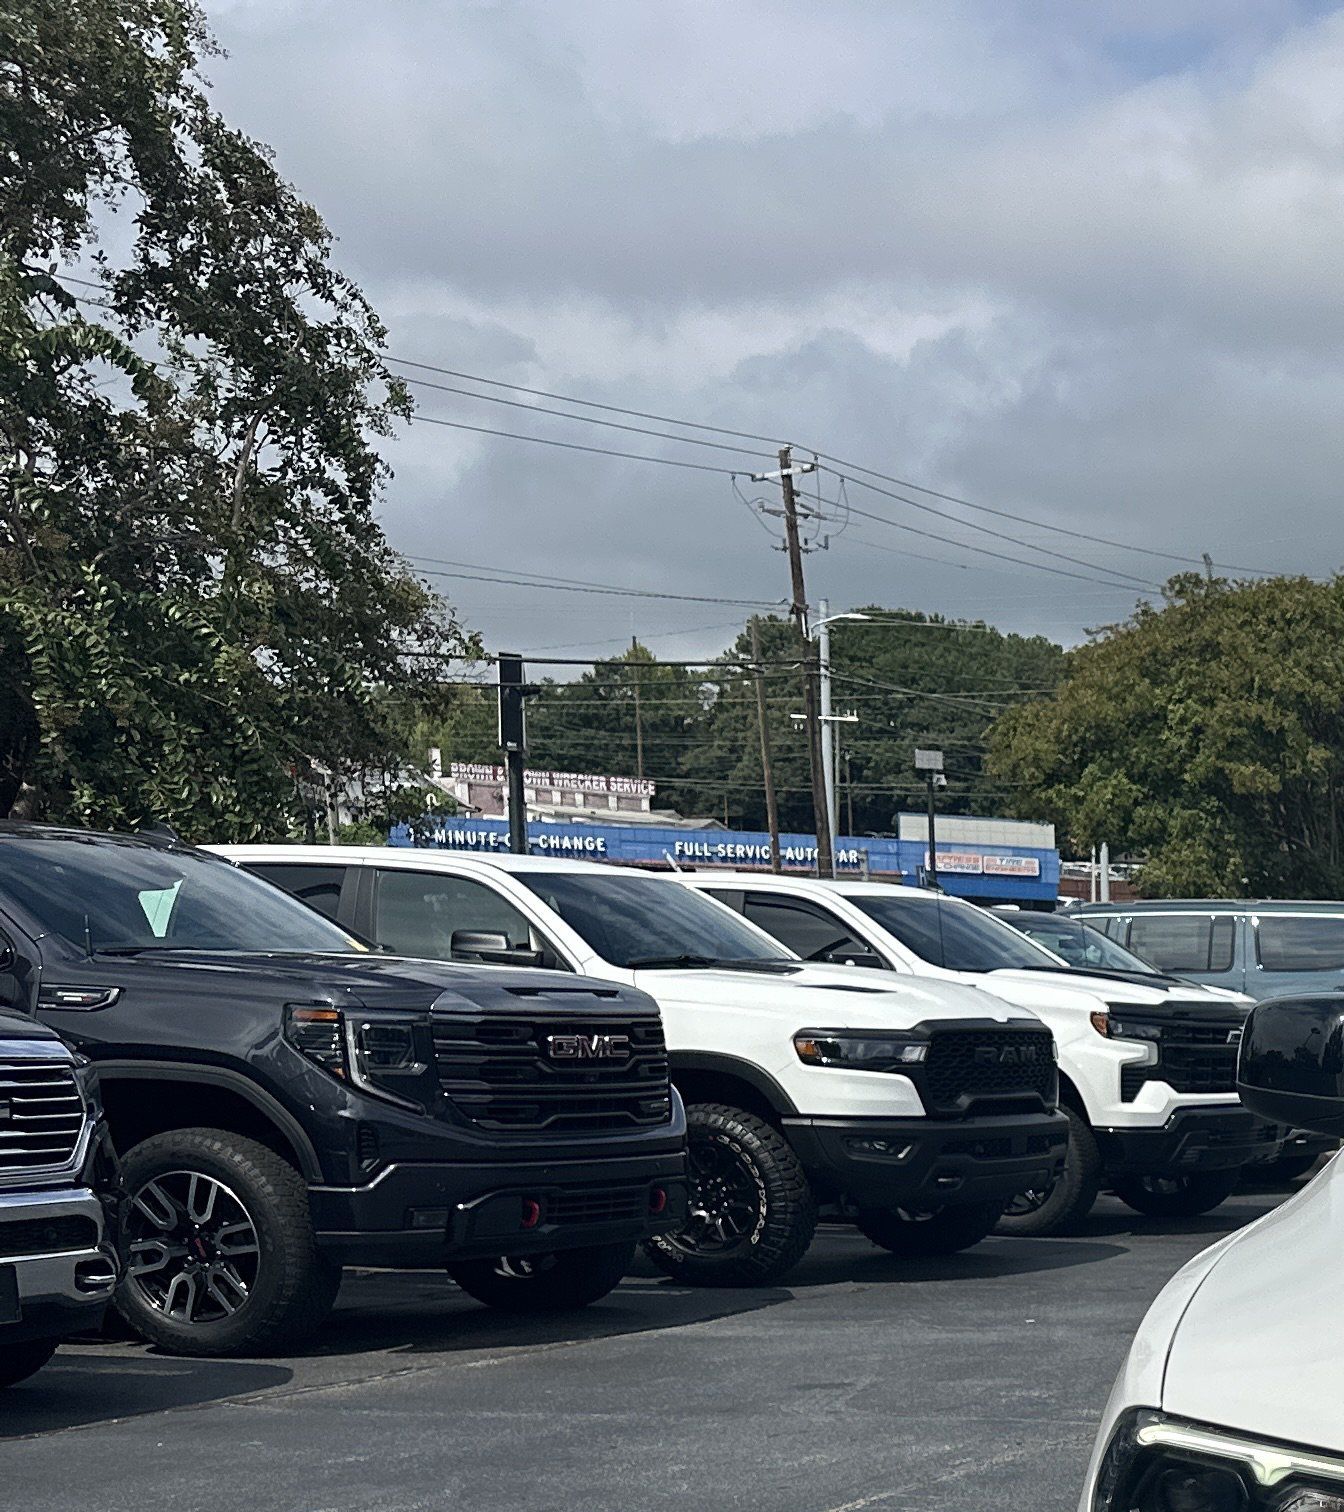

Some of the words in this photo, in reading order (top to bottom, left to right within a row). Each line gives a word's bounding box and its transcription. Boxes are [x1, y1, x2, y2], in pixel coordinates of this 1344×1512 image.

[523, 769, 550, 786] OWN
[553, 773, 607, 791] WRECKER
[610, 776, 656, 796] SERVICE
[435, 829, 498, 847] MINUTE
[539, 835, 606, 851] CHANGE
[675, 841, 711, 857] FULL
[717, 844, 770, 860] SERVIC
[547, 1035, 630, 1058] GMC
[975, 1046, 1036, 1062] RAM
